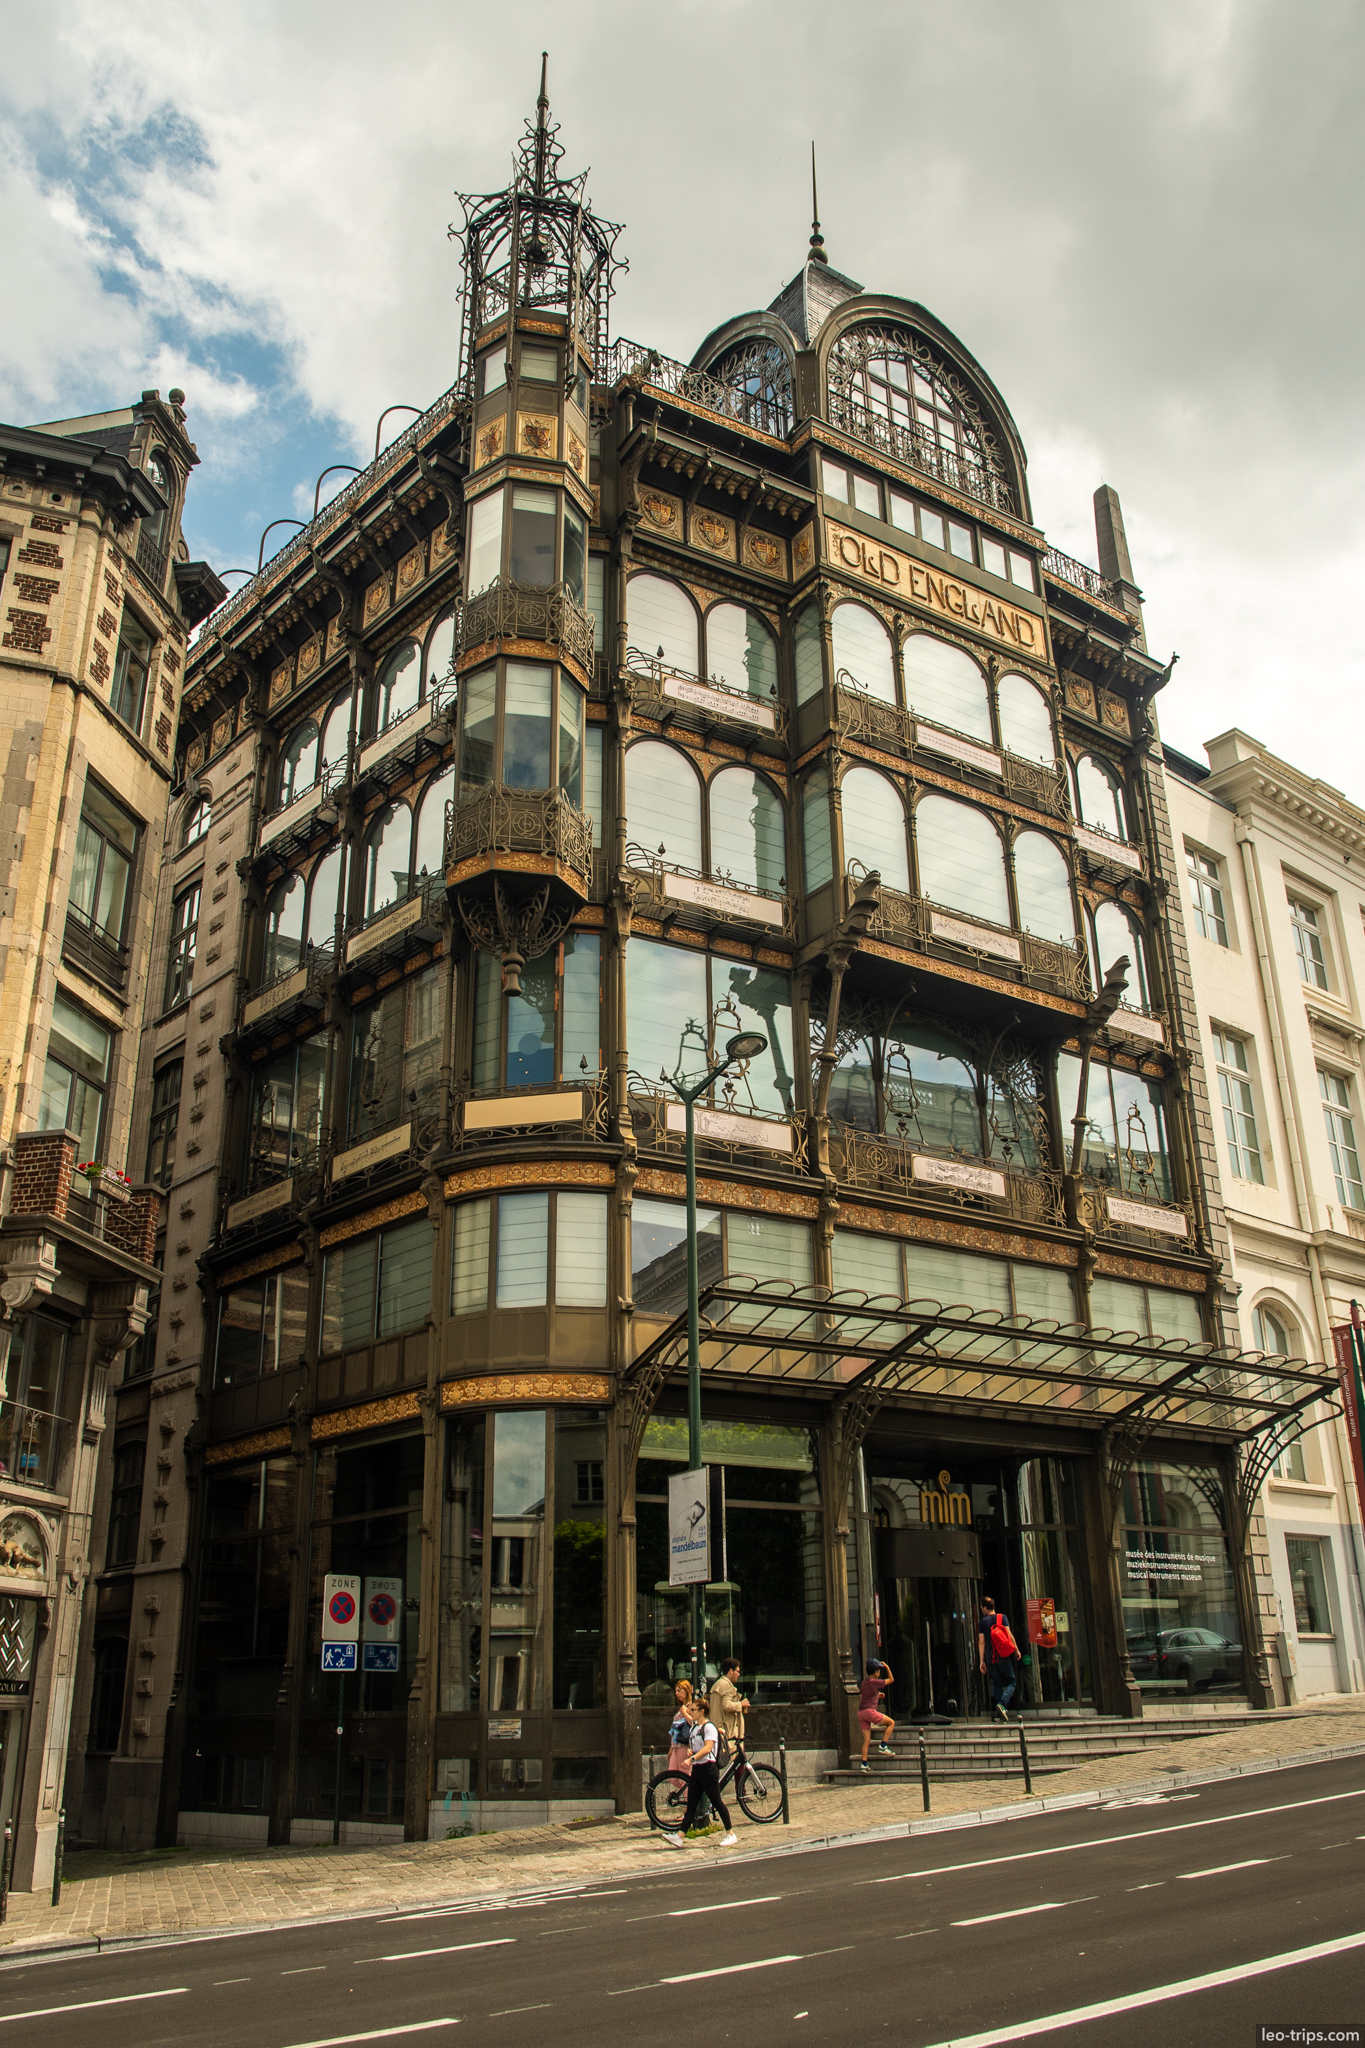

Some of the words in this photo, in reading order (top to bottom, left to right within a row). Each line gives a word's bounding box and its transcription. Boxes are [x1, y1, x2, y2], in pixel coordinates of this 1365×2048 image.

[839, 534, 900, 586] OLD
[909, 563, 1036, 648] ENGLAND
[919, 1469, 972, 1525] mim
[672, 1540, 706, 1554] mandelbaum
[1125, 1549, 1144, 1559] musée
[1144, 1550, 1155, 1559] des
[1155, 1550, 1186, 1561] instruments
[1186, 1552, 1194, 1561] de
[1194, 1553, 1216, 1563] musique
[1127, 1570, 1149, 1579] musical
[1149, 1571, 1180, 1580] instruments
[1180, 1573, 1203, 1581] museum
[331, 1578, 356, 1588] ZONE
